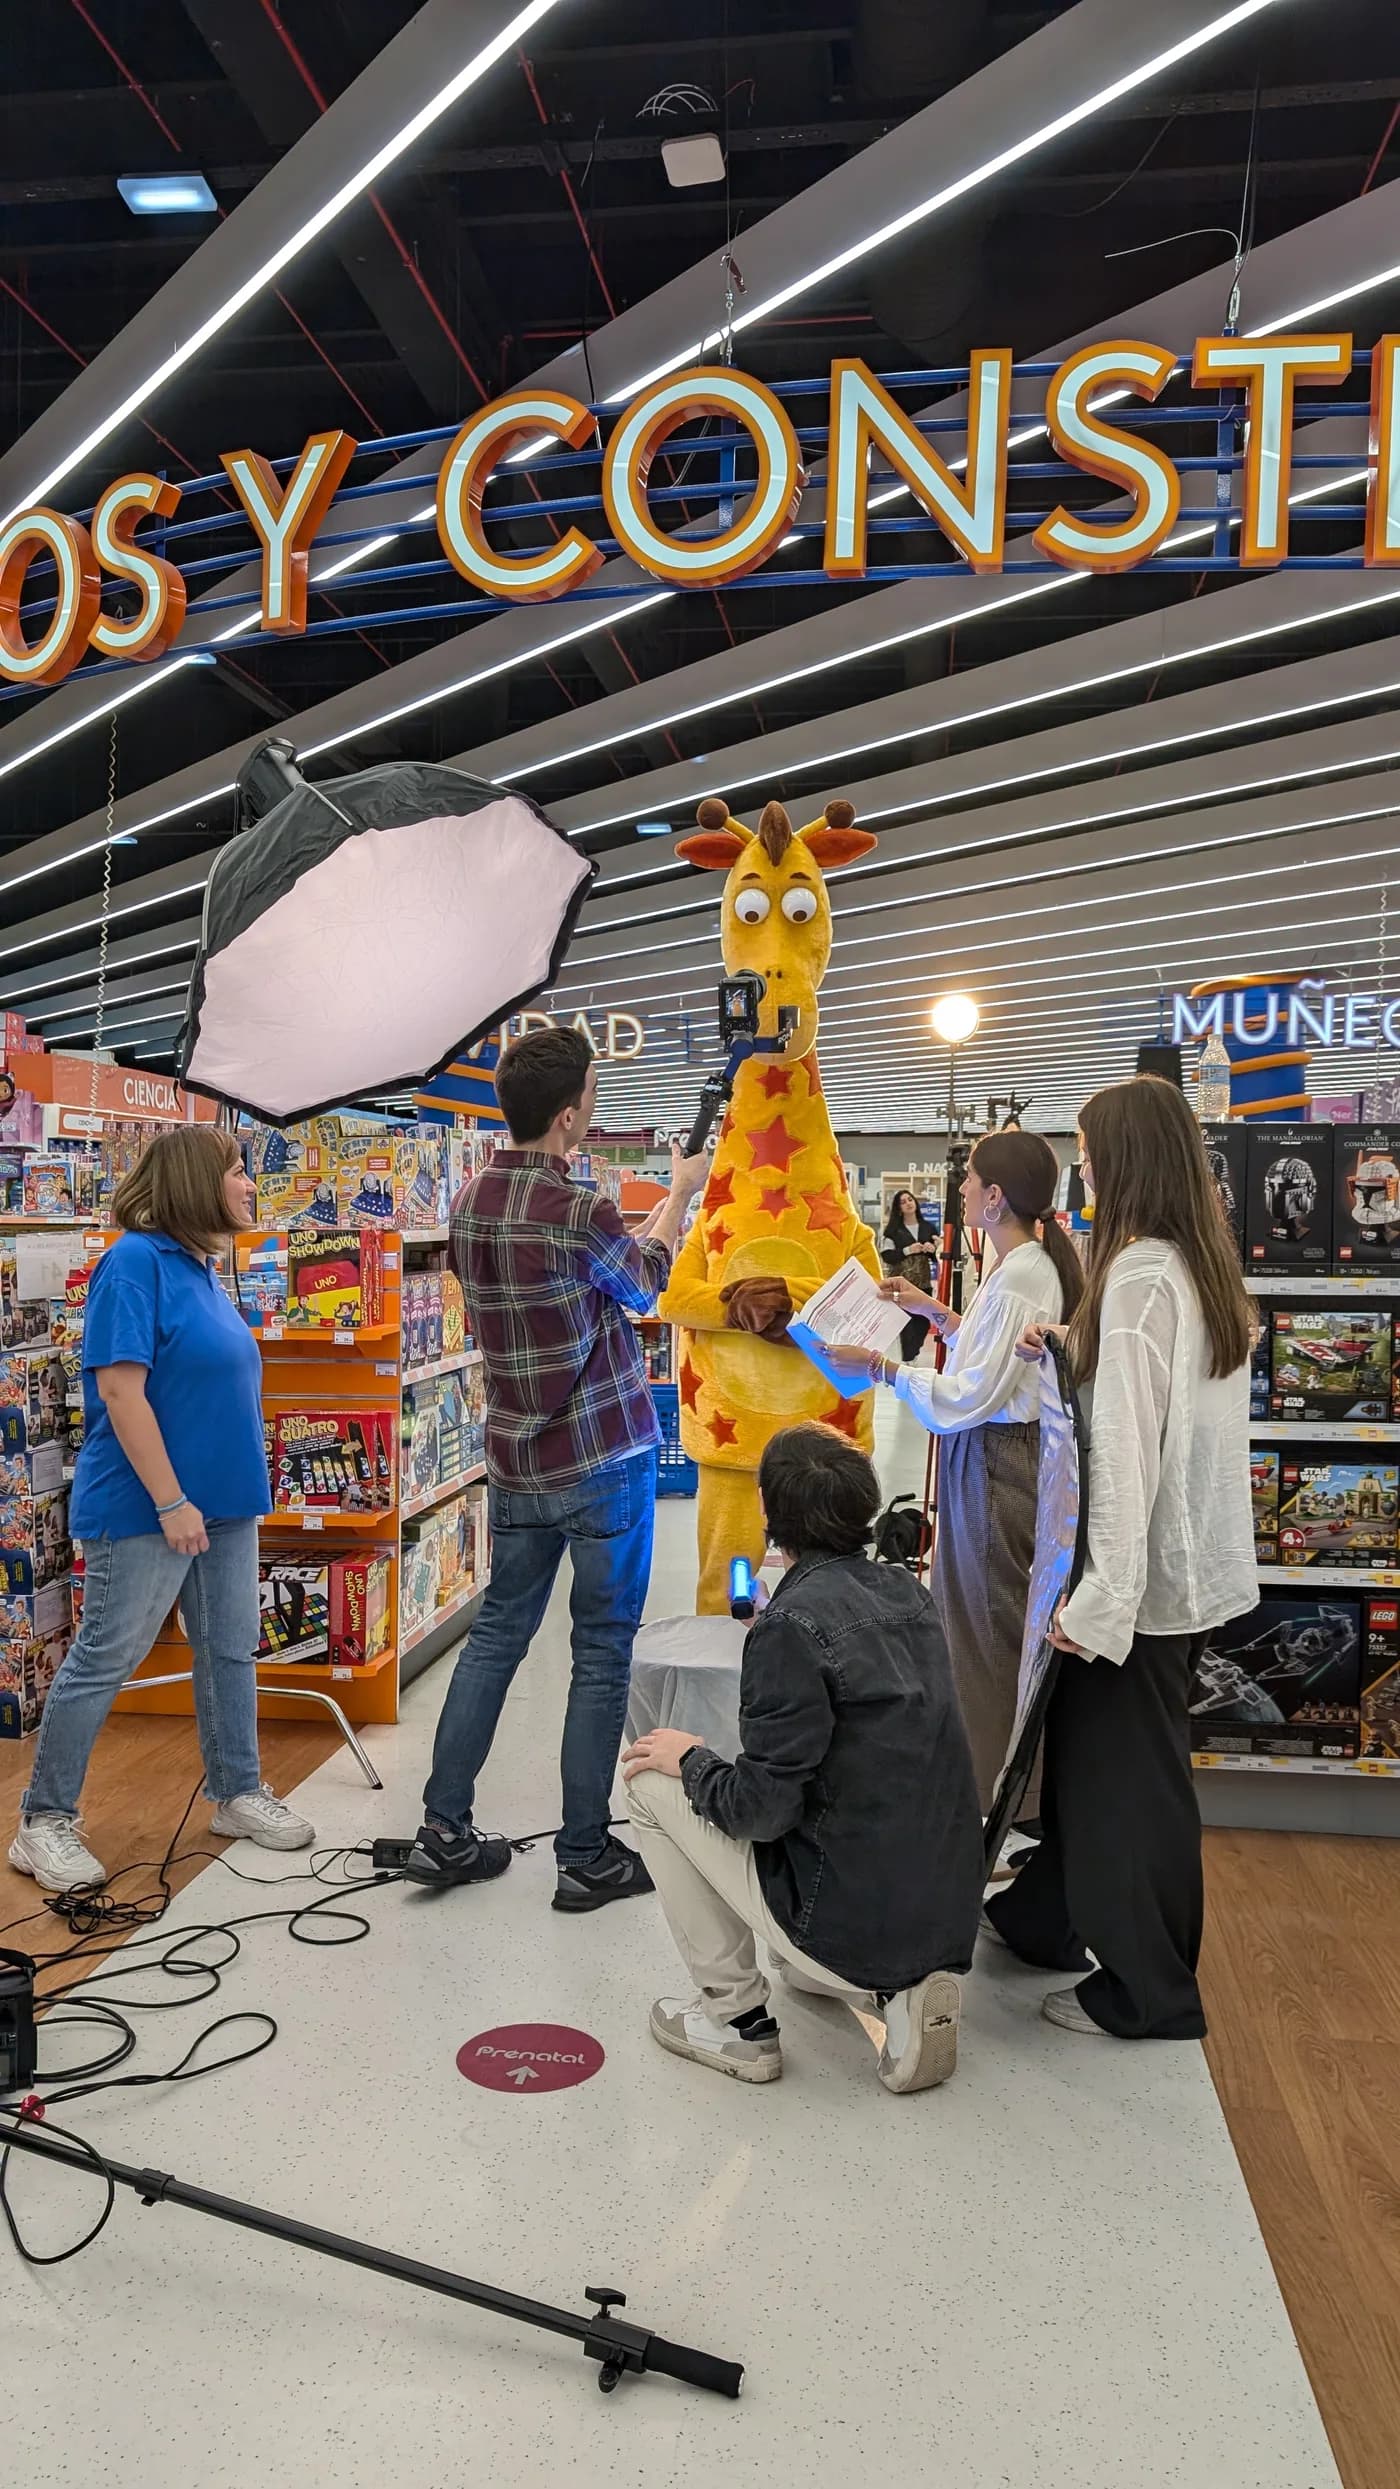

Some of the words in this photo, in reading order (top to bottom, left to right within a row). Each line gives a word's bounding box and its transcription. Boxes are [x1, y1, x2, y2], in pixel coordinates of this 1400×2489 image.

[220, 430, 358, 635] Y
[436, 333, 1400, 602] CONST
[124, 1078, 180, 1112] CIENCIA
[290, 1230, 318, 1245] UNO
[288, 1235, 360, 1258] SHOWDOWN
[313, 1275, 336, 1290] UNO
[66, 1282, 89, 1303] UN
[1292, 1321, 1325, 1329] WARS
[280, 1416, 308, 1429] UNO
[279, 1420, 339, 1442] QUATRO
[1300, 1473, 1332, 1482] WARS
[1302, 1467, 1331, 1475] STAR
[1282, 1532, 1303, 1545] 4+
[268, 1566, 320, 1581] RACE
[354, 1573, 365, 1596] UNO
[344, 1571, 361, 1632] SHOWDOWN
[1371, 1610, 1396, 1622] LEGO
[1368, 1633, 1385, 1643] 9+
